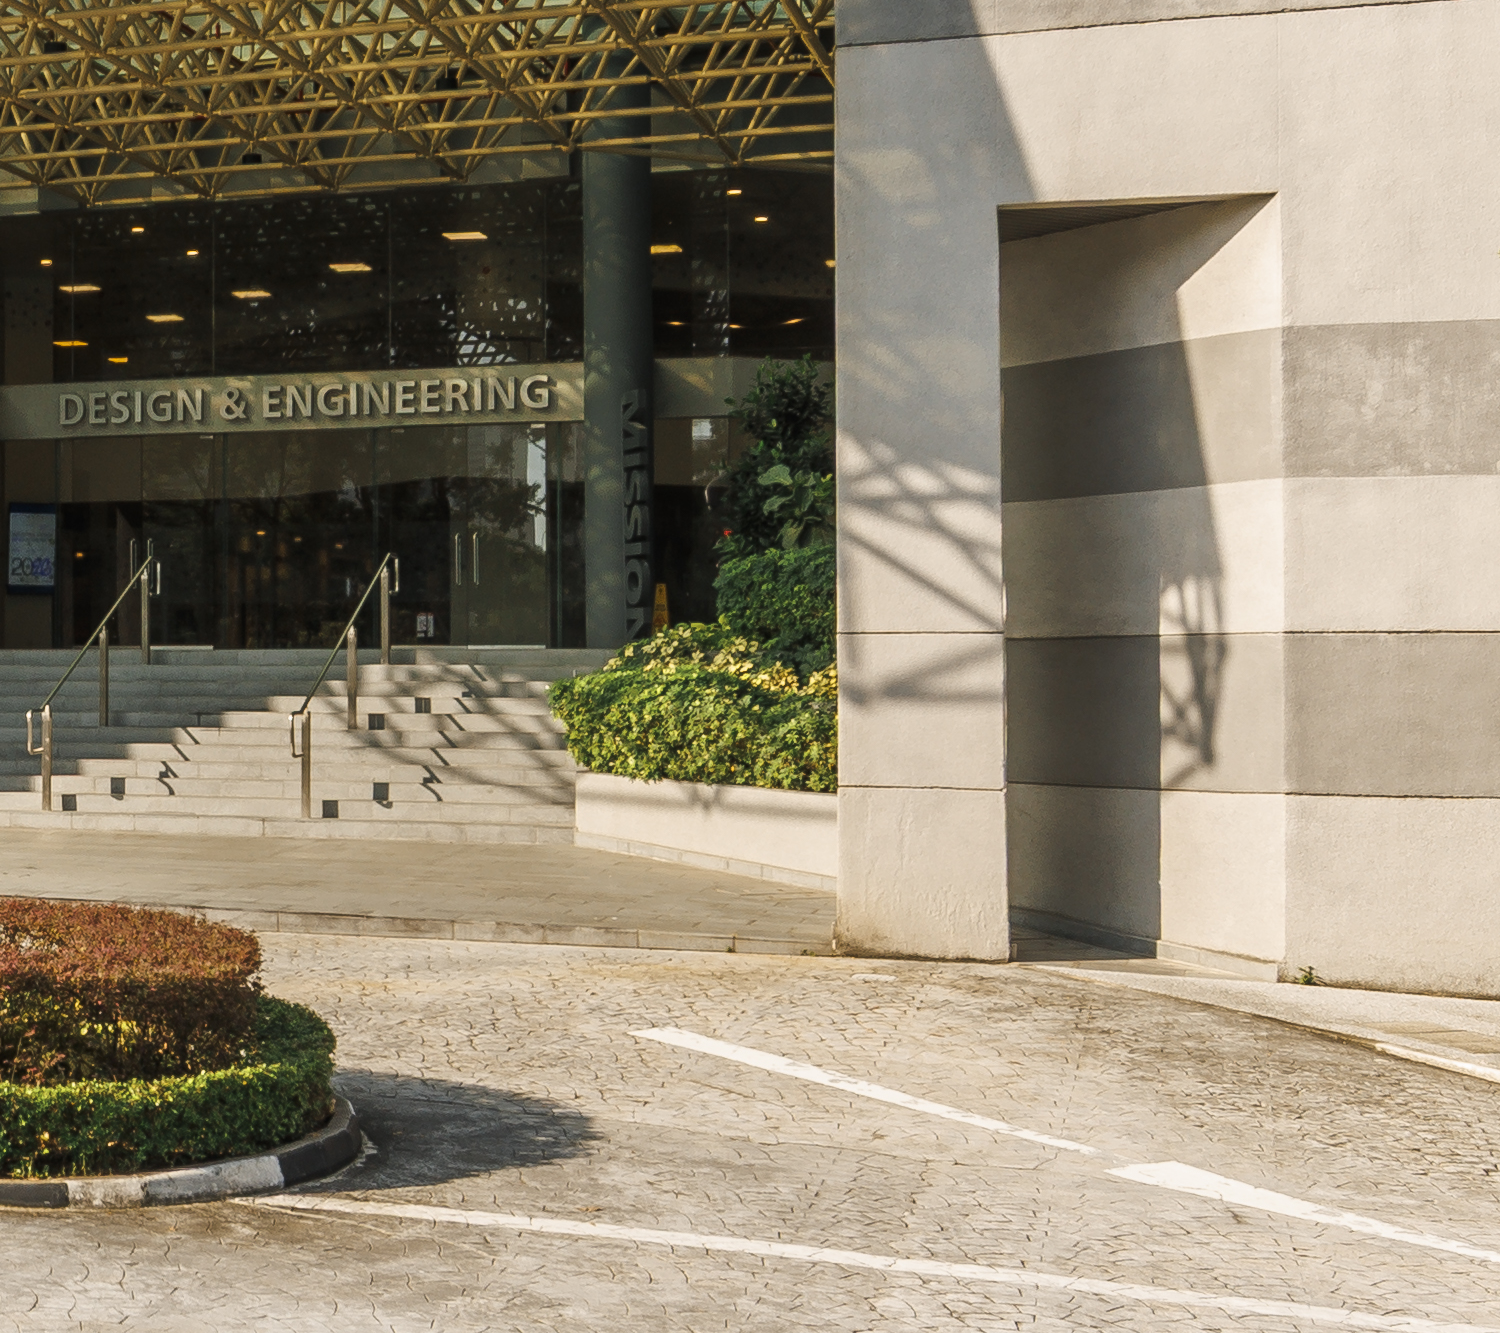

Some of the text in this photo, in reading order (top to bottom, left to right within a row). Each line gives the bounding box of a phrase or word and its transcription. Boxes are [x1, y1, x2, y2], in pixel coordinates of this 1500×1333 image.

[59, 374, 551, 425] DESIGN & ENGINEERING
[621, 389, 647, 640] MISSION
